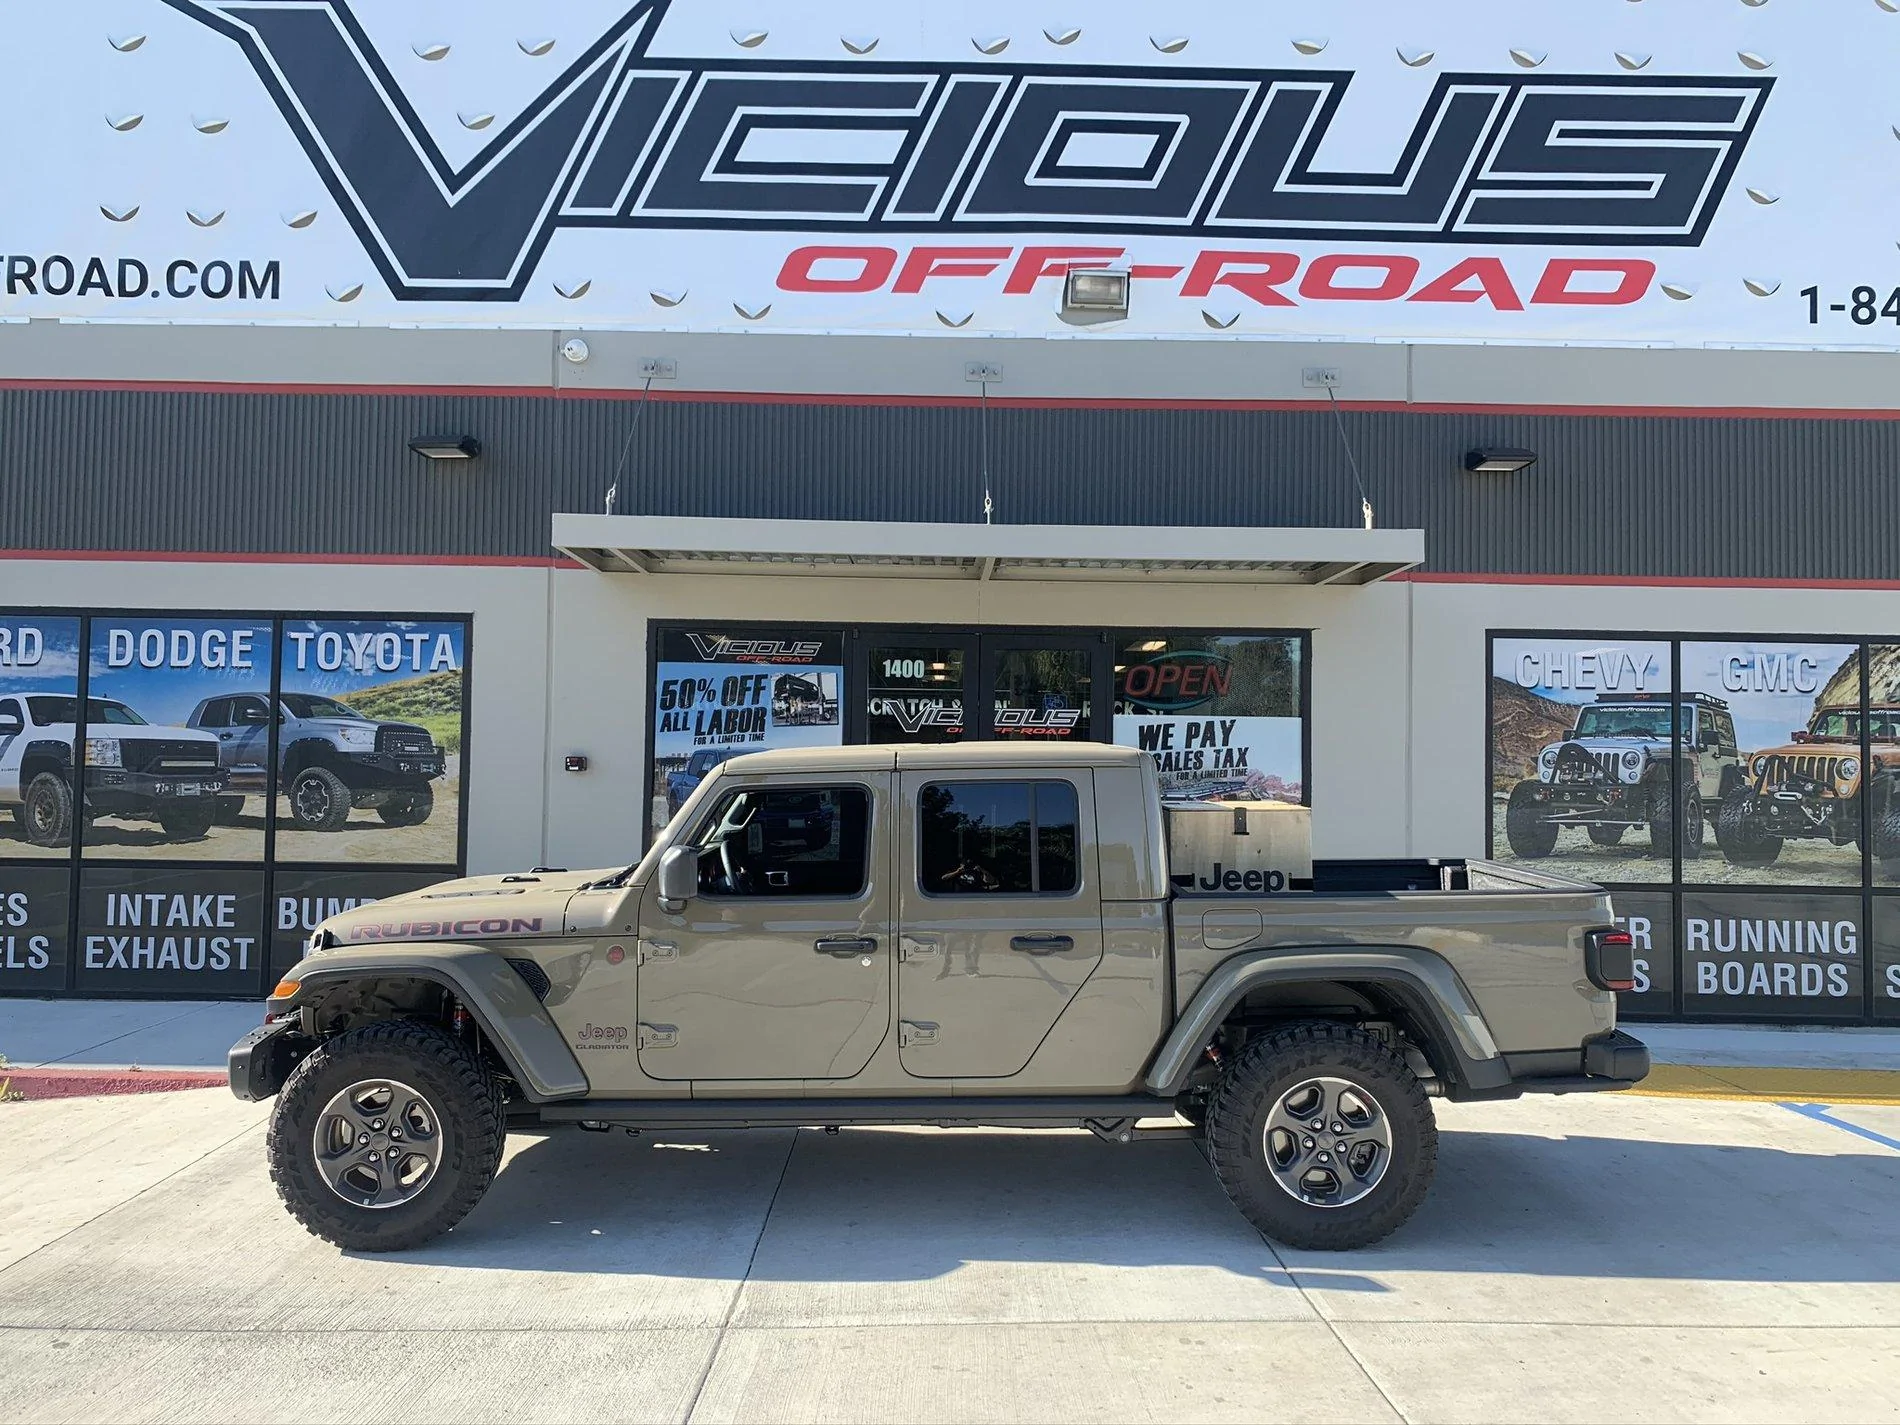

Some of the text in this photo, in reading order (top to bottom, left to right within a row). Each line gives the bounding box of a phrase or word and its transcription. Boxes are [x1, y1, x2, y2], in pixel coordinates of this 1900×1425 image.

[0, 255, 280, 299] ROAD.COM
[776, 246, 1656, 311] OFF-ROAD
[108, 629, 254, 668] DODGE
[290, 631, 457, 671] TOYOTA
[685, 633, 822, 660] VICIOUS
[736, 655, 813, 663] OFF-ROAD
[883, 659, 925, 678] 1400
[1124, 664, 1233, 698] OPEN
[1515, 650, 1654, 689] CHEVY
[1722, 652, 1818, 692] GMC
[659, 674, 769, 711] 50% OFF
[659, 706, 768, 736] ALL LABOR
[1138, 719, 1237, 751] WE PAY
[693, 733, 765, 746] FOR A LIMITED TIME
[1176, 768, 1248, 781] FOR A LIMITED TIME
[1213, 747, 1249, 769] TAX
[1200, 863, 1284, 892] Jeep
[106, 894, 237, 928] INTAKE
[350, 918, 543, 940] RUBICON
[1687, 917, 1857, 955] RUNNING
[85, 936, 255, 970] EXHAUST
[1698, 961, 1849, 998] BOARDS
[578, 1022, 628, 1043] Jeep
